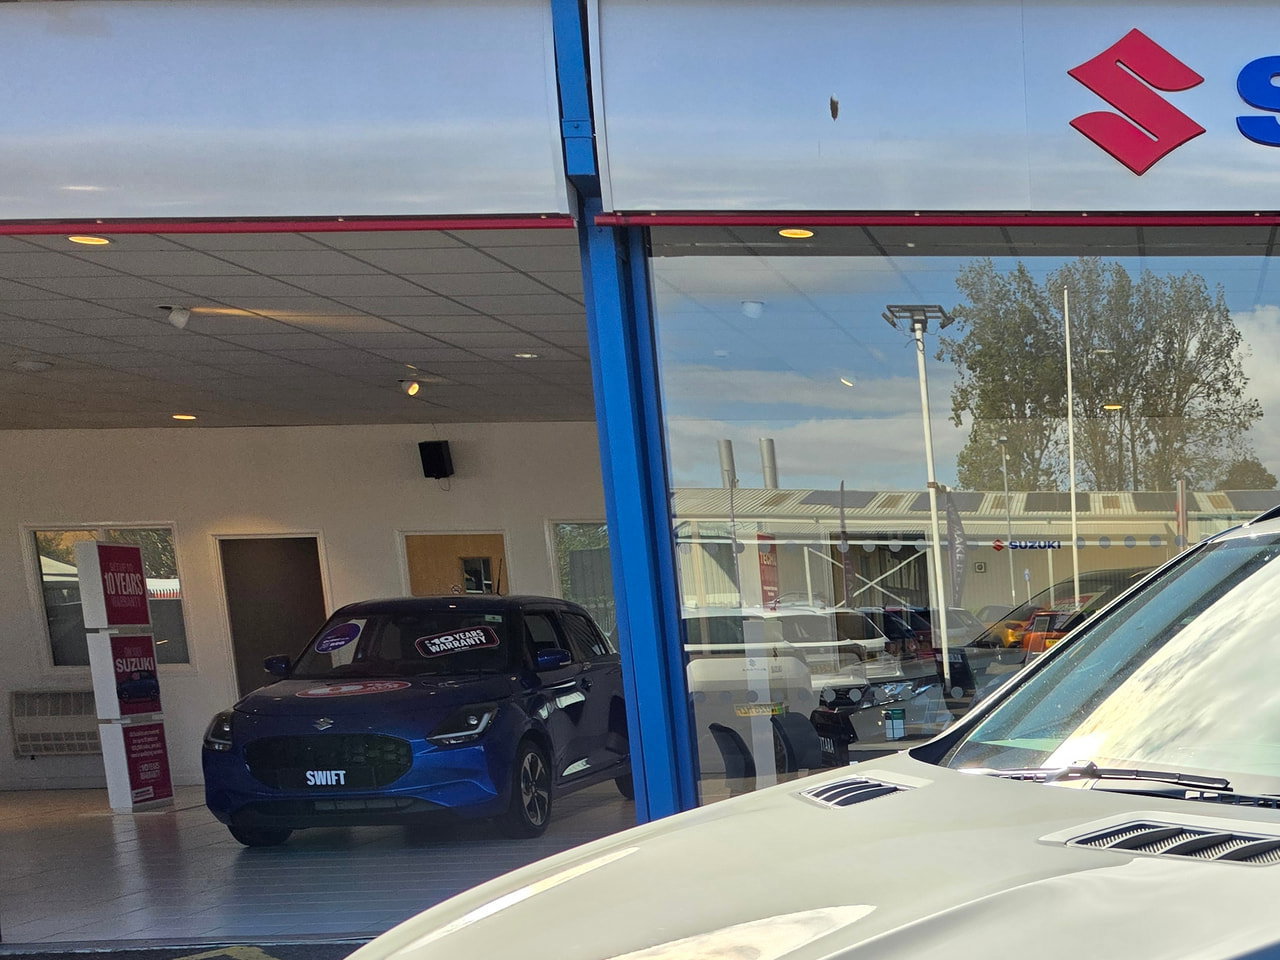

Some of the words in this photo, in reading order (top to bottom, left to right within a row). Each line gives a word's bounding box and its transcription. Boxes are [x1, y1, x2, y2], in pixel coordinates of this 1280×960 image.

[1008, 540, 1061, 550] SUZUKI
[104, 572, 115, 595] 10
[115, 572, 143, 595] YEARS
[429, 635, 487, 653] WARRANTY
[431, 635, 453, 646] 10
[453, 629, 484, 643] YEARS
[115, 656, 155, 673] SUZUKI
[305, 770, 346, 786] SWIFT
